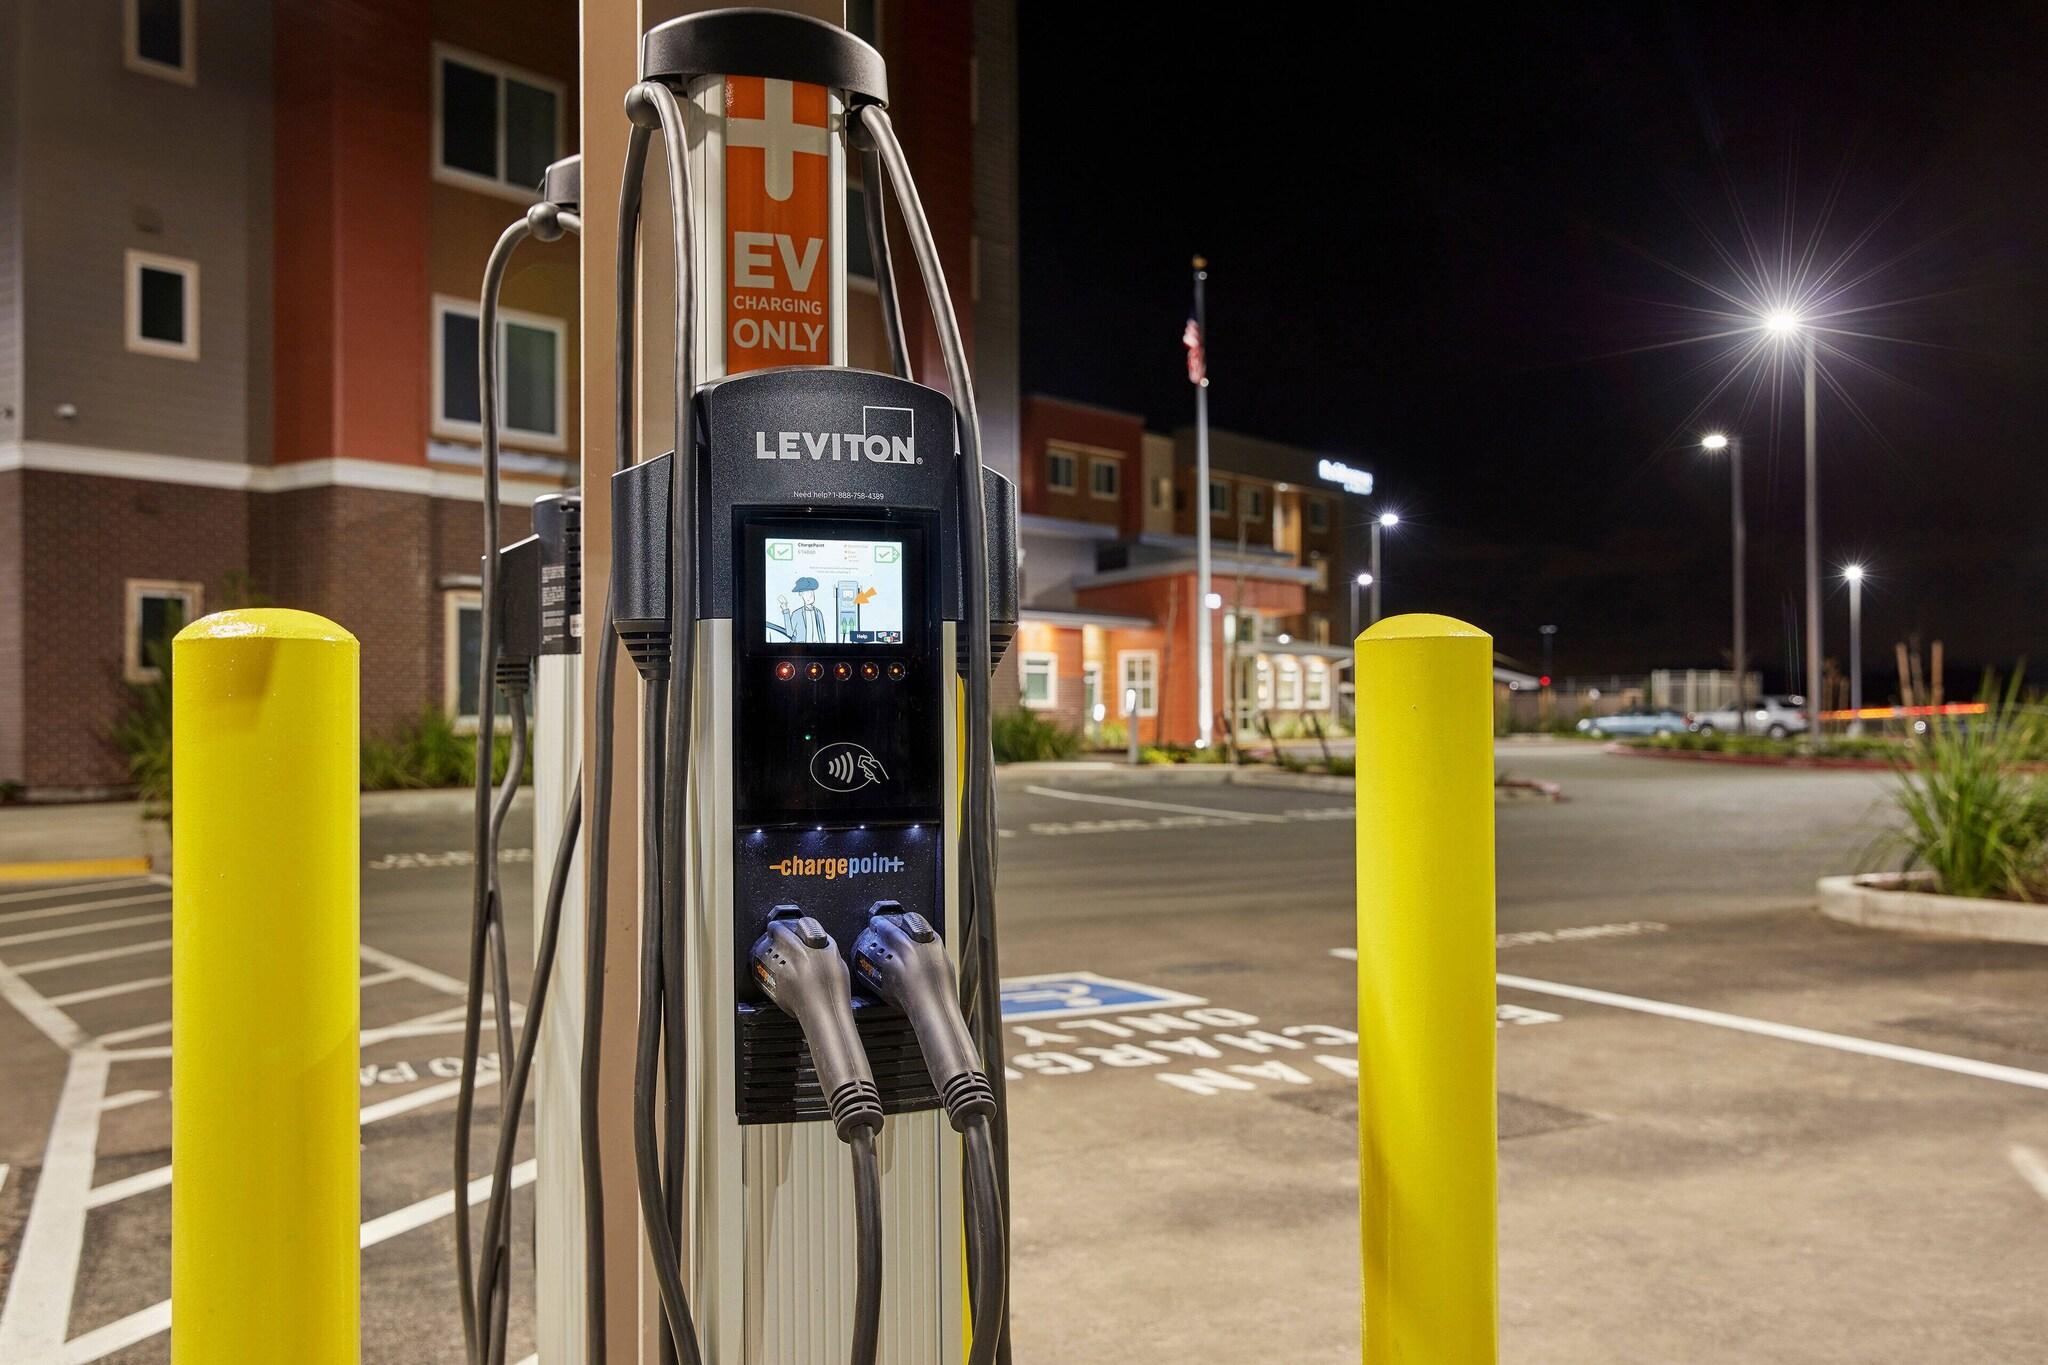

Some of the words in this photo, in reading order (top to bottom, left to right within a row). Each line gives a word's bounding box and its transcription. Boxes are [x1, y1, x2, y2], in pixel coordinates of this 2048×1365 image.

[733, 230, 824, 293] EV
[732, 295, 823, 316] CHARGING
[732, 317, 825, 354] ONLY
[756, 431, 915, 464] LEVITON
[793, 490, 812, 498] Need
[813, 490, 832, 499] help?
